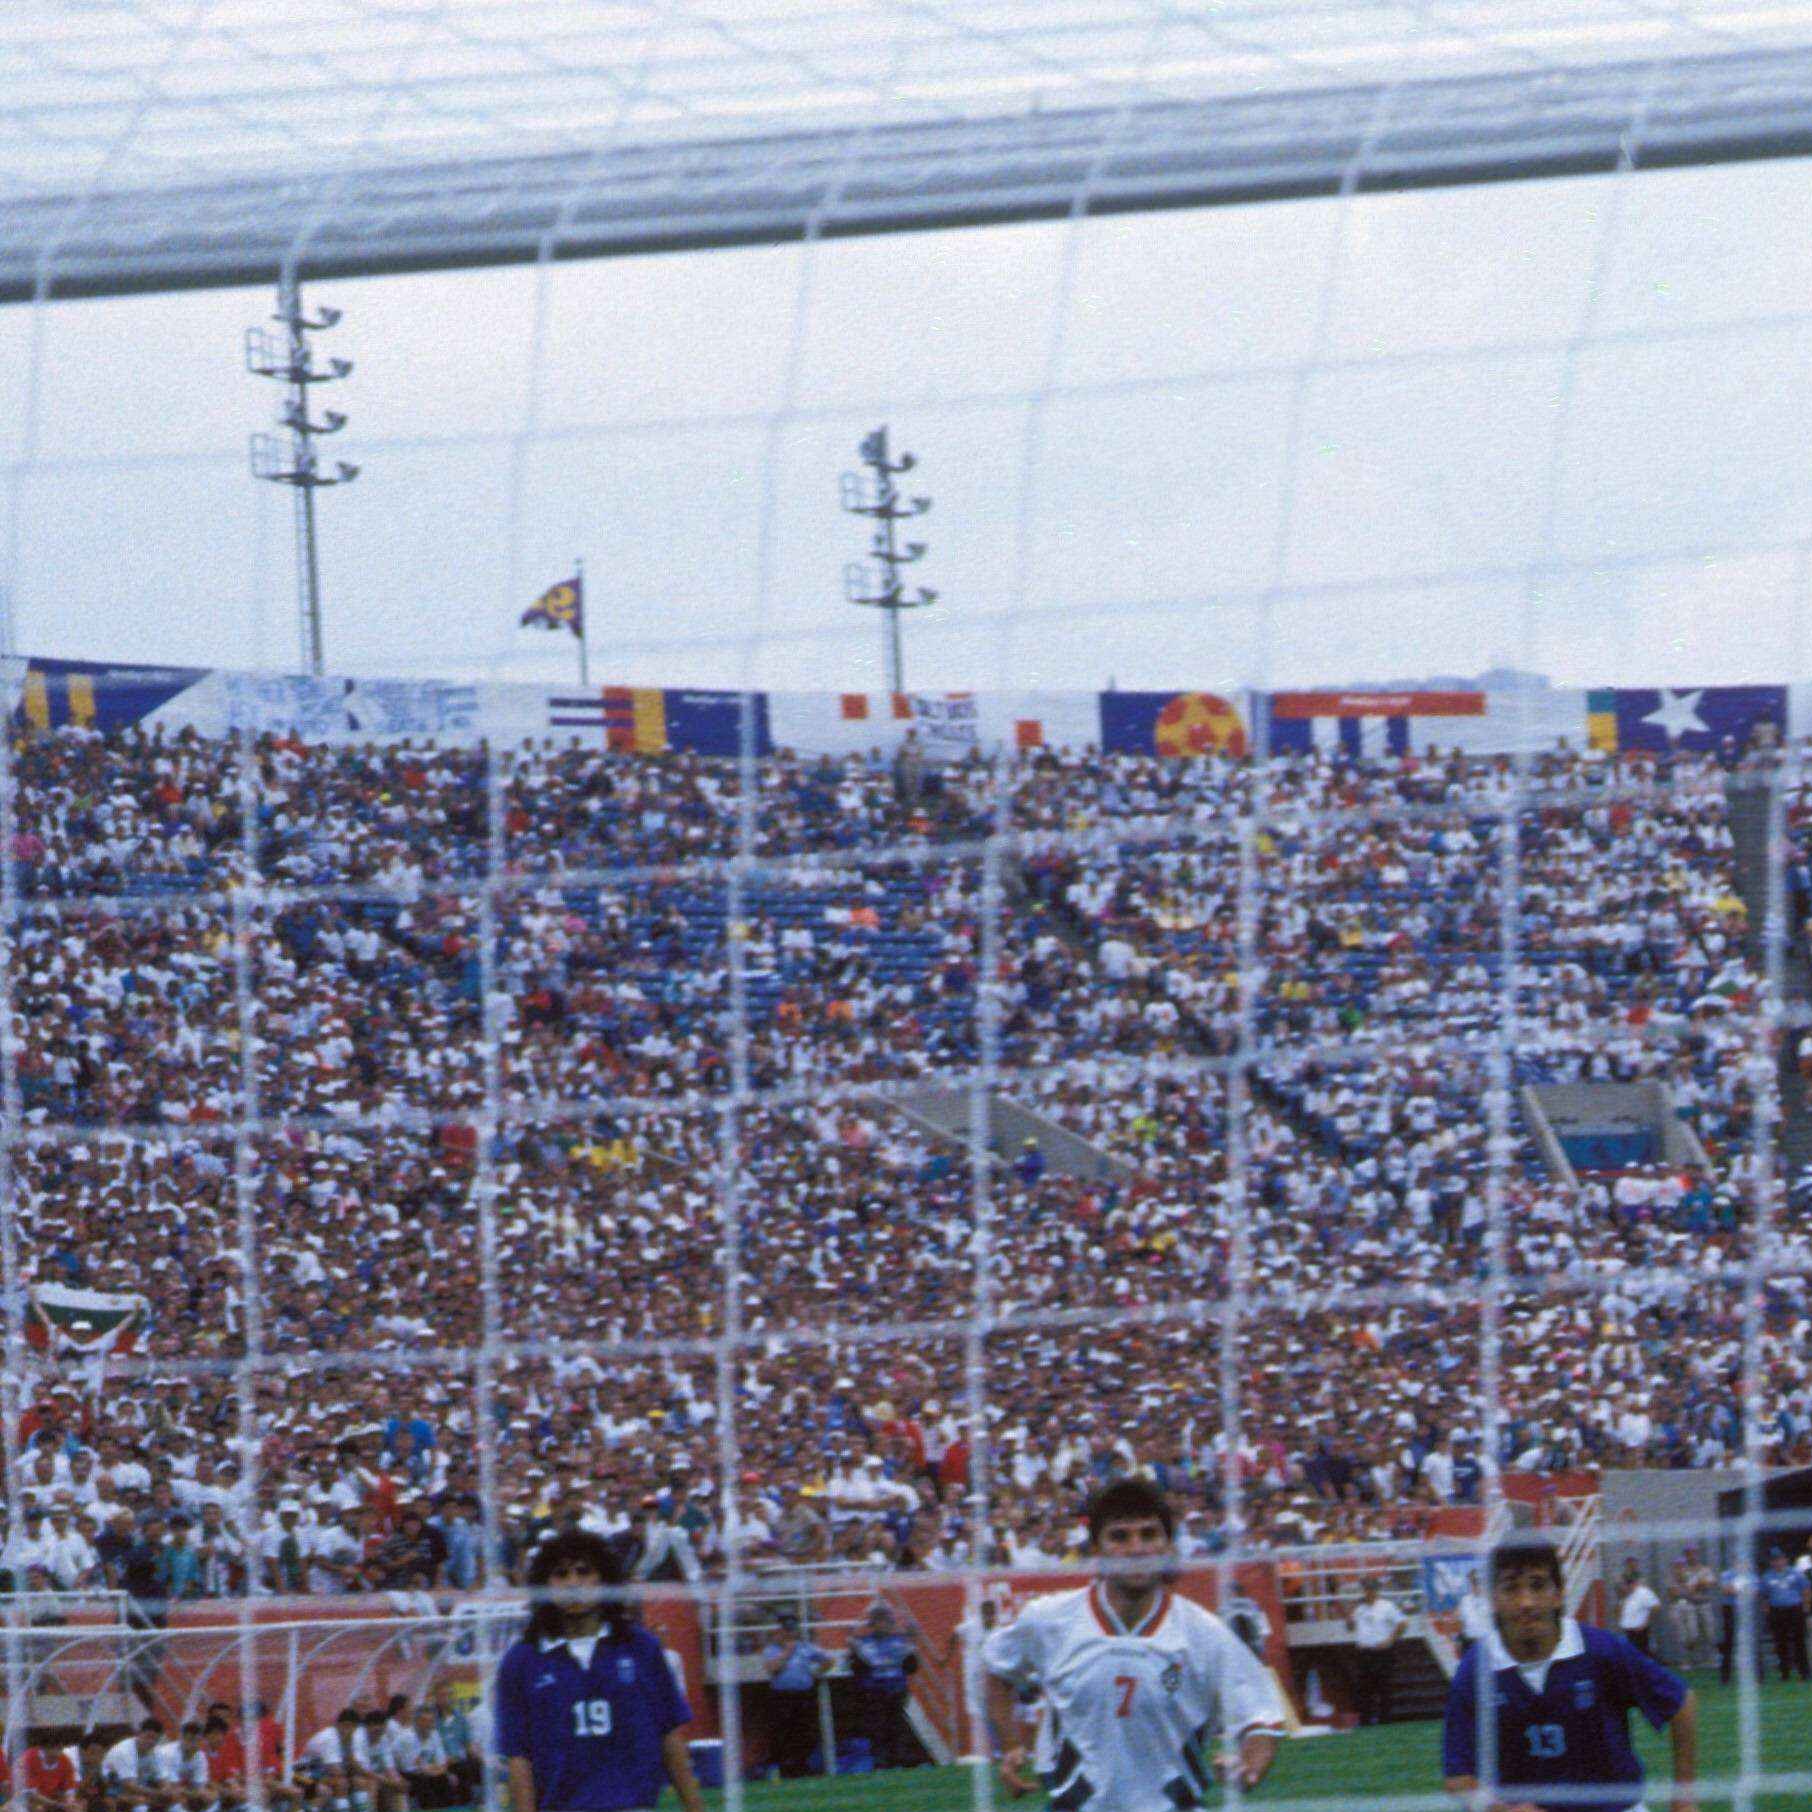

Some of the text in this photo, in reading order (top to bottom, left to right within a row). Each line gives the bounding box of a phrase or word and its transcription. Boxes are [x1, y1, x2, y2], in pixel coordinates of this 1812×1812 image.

[1114, 1675, 1138, 1719] 7
[571, 1698, 612, 1736] 19
[1522, 1722, 1568, 1758] 13
